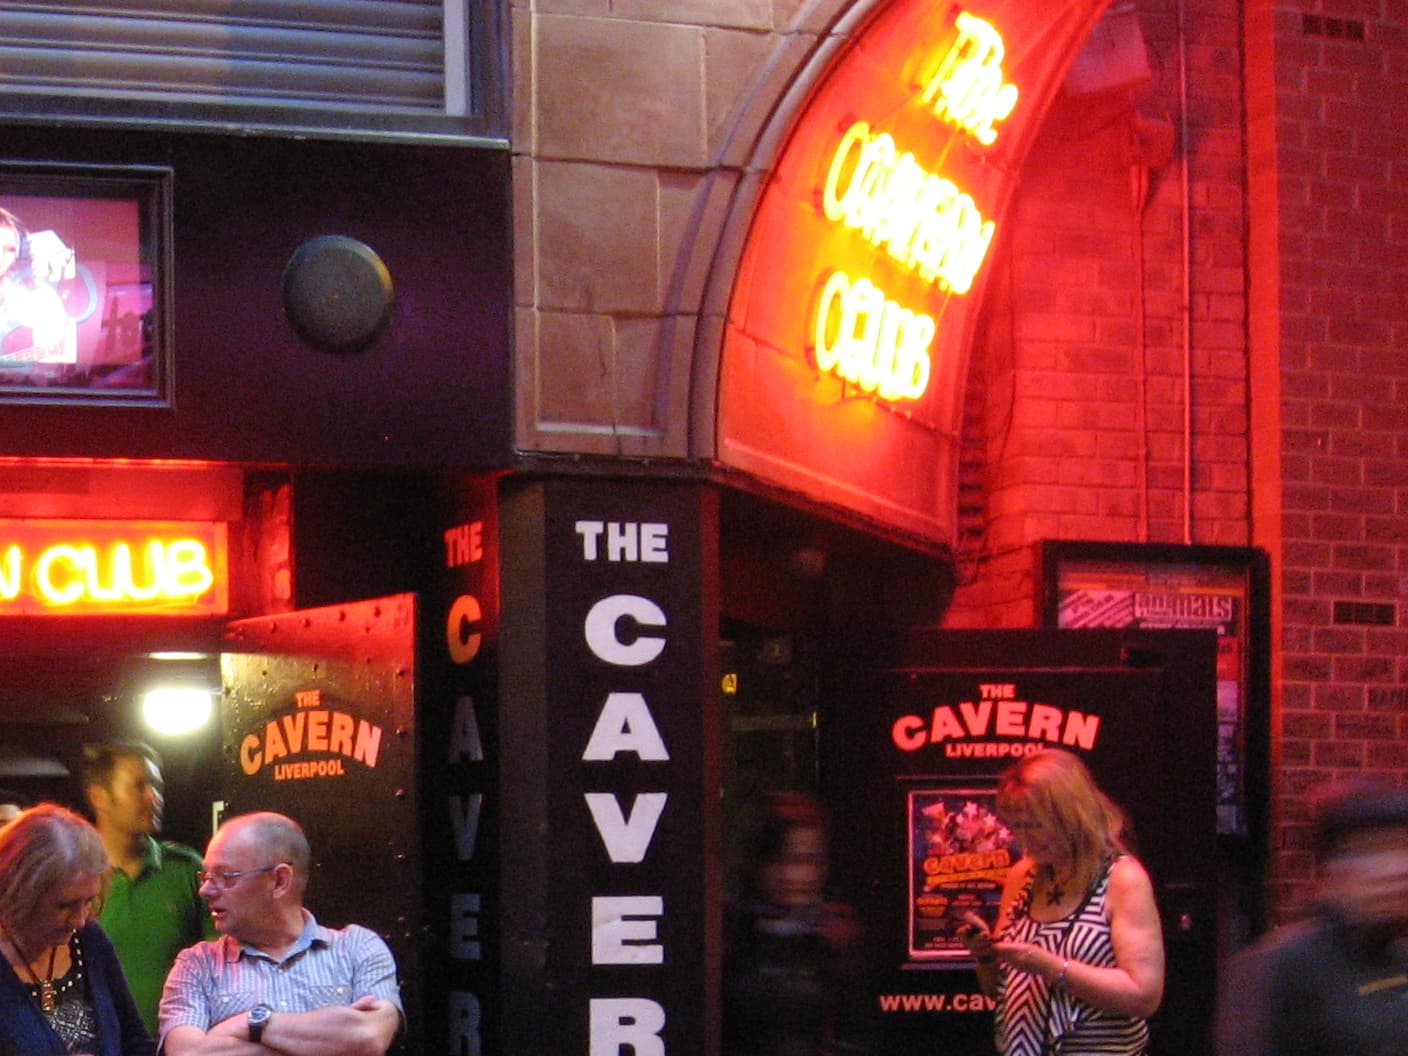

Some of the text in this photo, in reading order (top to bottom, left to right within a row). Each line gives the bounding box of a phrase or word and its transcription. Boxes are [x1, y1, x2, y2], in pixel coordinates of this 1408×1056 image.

[445, 520, 484, 568] THE
[575, 521, 669, 563] THE
[36, 537, 216, 605] CLUB
[295, 689, 321, 708] THE
[978, 684, 1016, 700] THE
[240, 710, 382, 776] CAVERN
[891, 700, 1102, 751] CAVERN
[274, 759, 344, 780] LIVERPOOL
[879, 991, 998, 1012] www.cav
